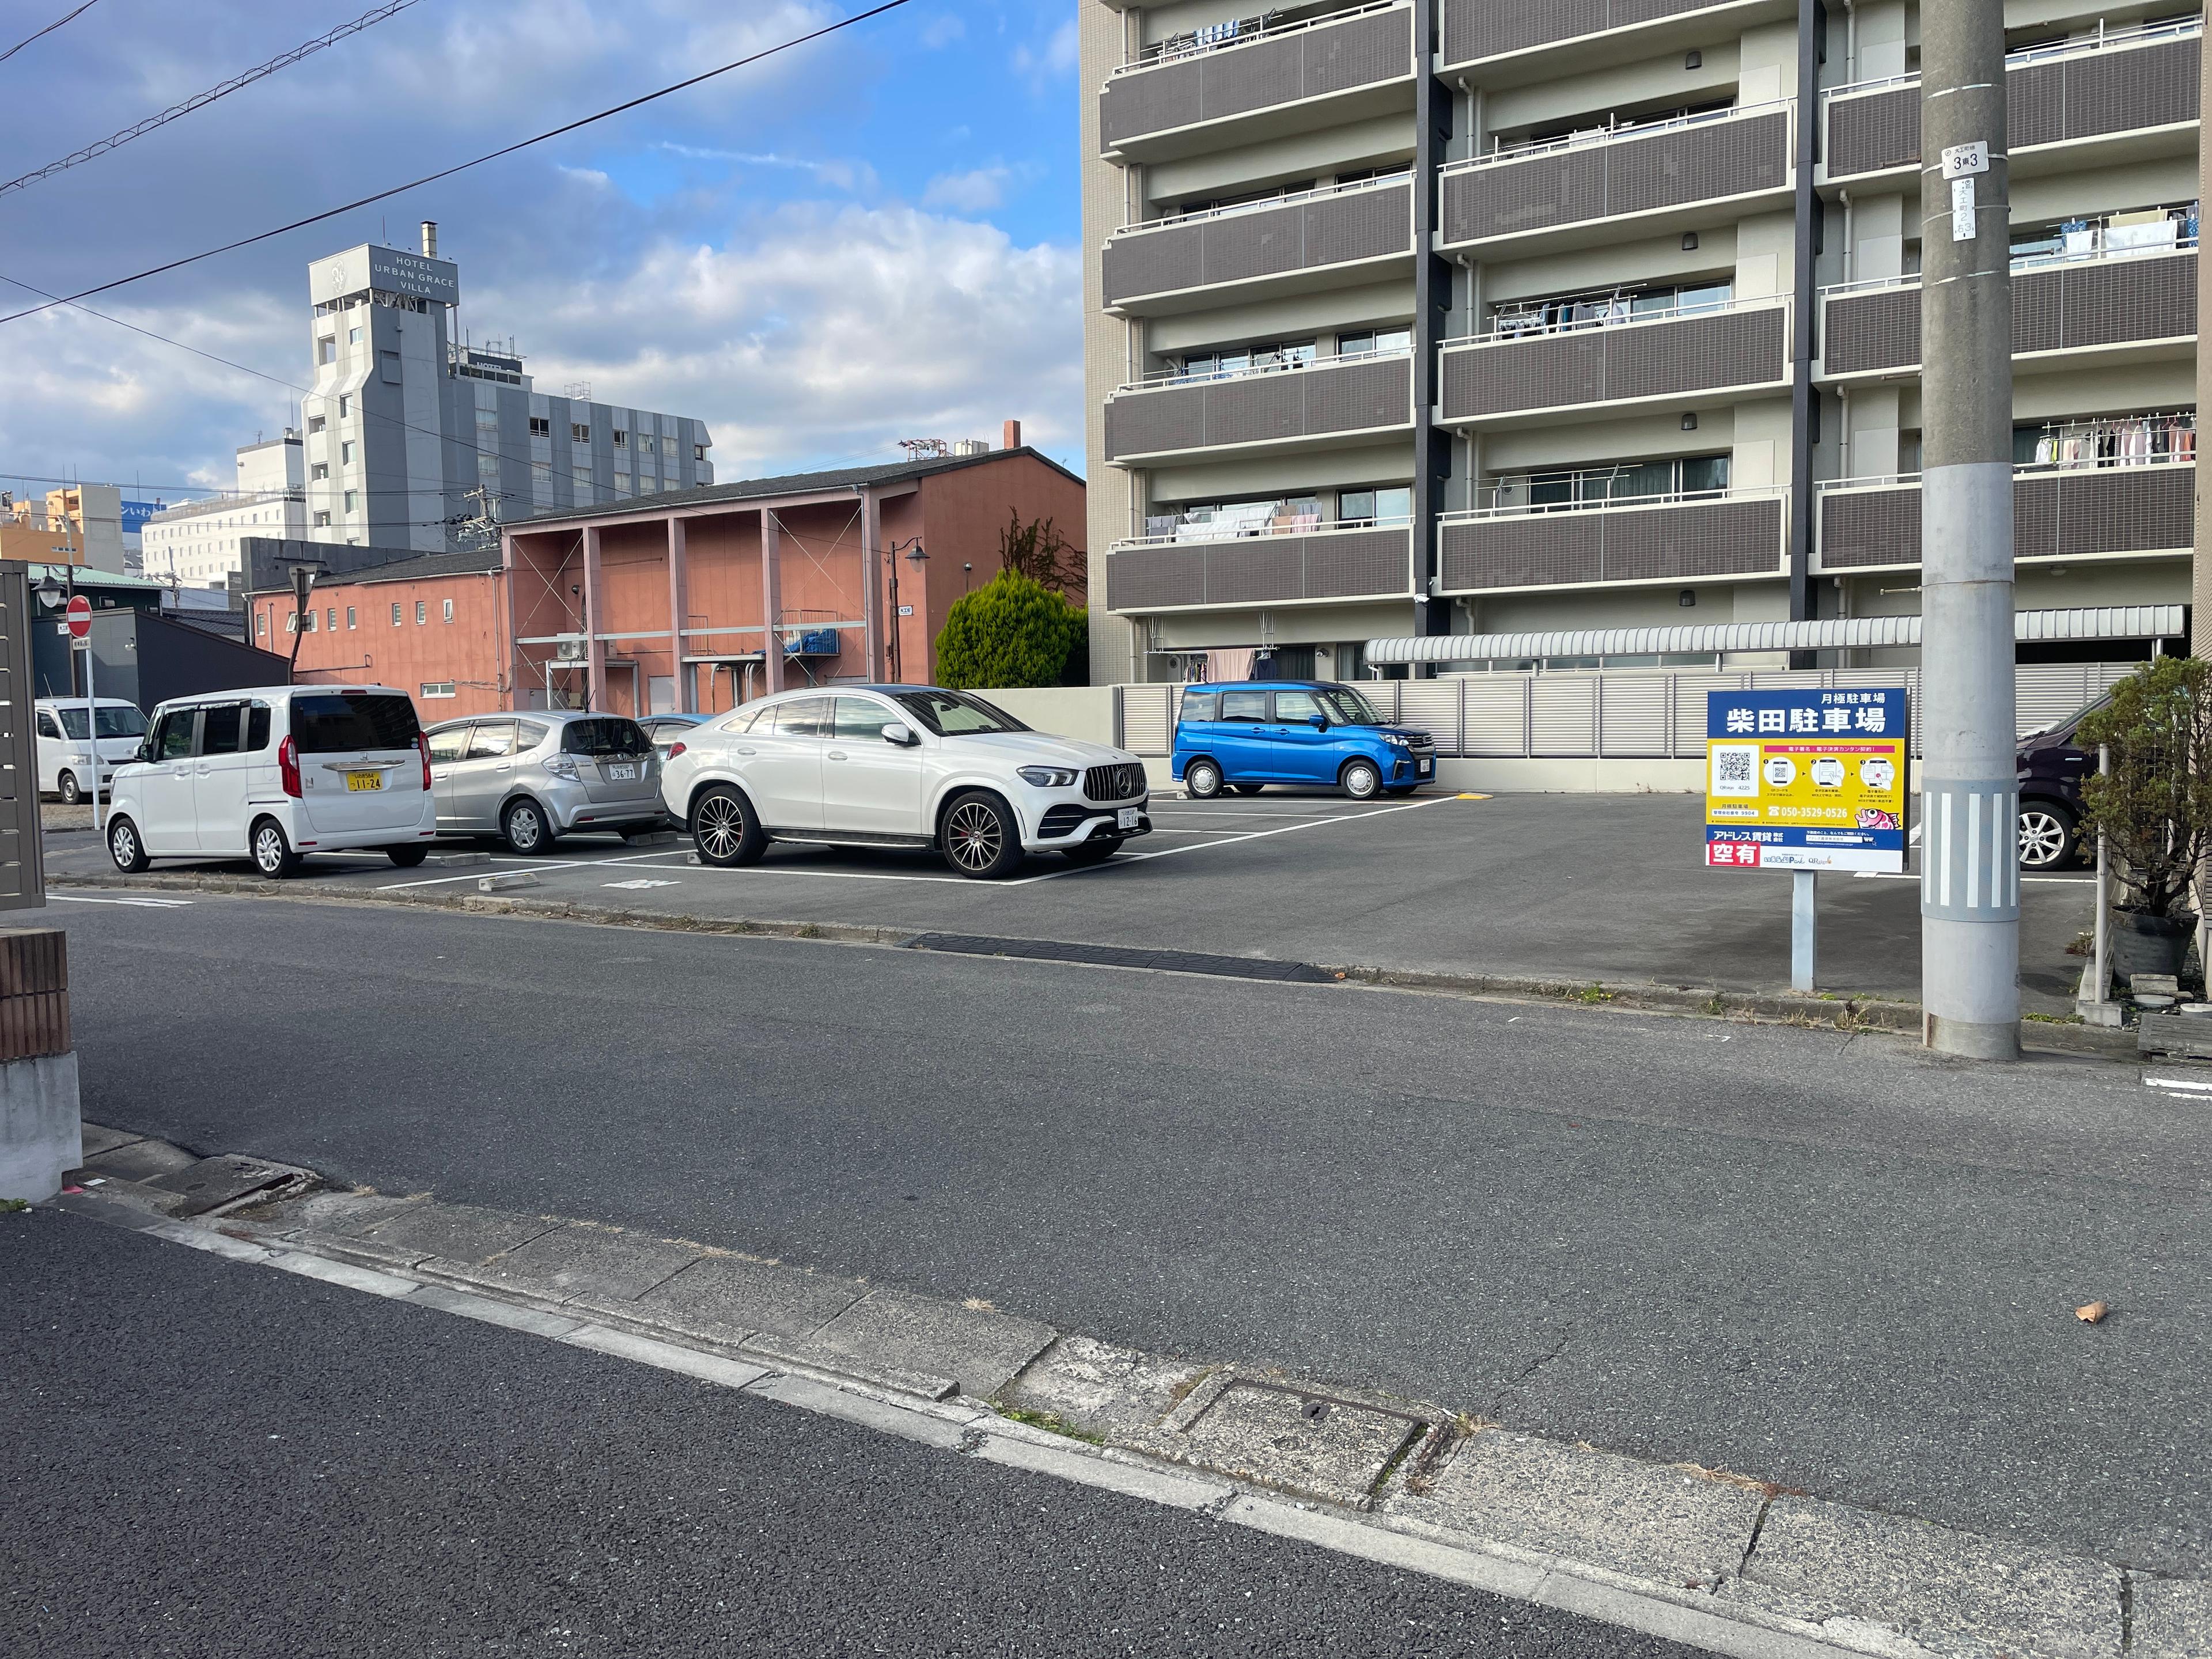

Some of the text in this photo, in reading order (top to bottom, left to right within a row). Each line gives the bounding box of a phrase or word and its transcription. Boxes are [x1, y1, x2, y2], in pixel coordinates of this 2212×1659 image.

[396, 256, 433, 271] HOTEL
[375, 264, 454, 287] URBAN GRACE
[400, 281, 431, 294] VILLA
[1821, 692, 1886, 704] 月極駐車場
[1726, 707, 1886, 733] 柴田駐車場
[616, 770, 633, 778] 36-77
[357, 779, 380, 789] 11-24
[1782, 807, 1847, 818] 050-3529-0526
[1714, 831, 1772, 842] アドレス賃貸
[1713, 843, 1758, 864] 空有
